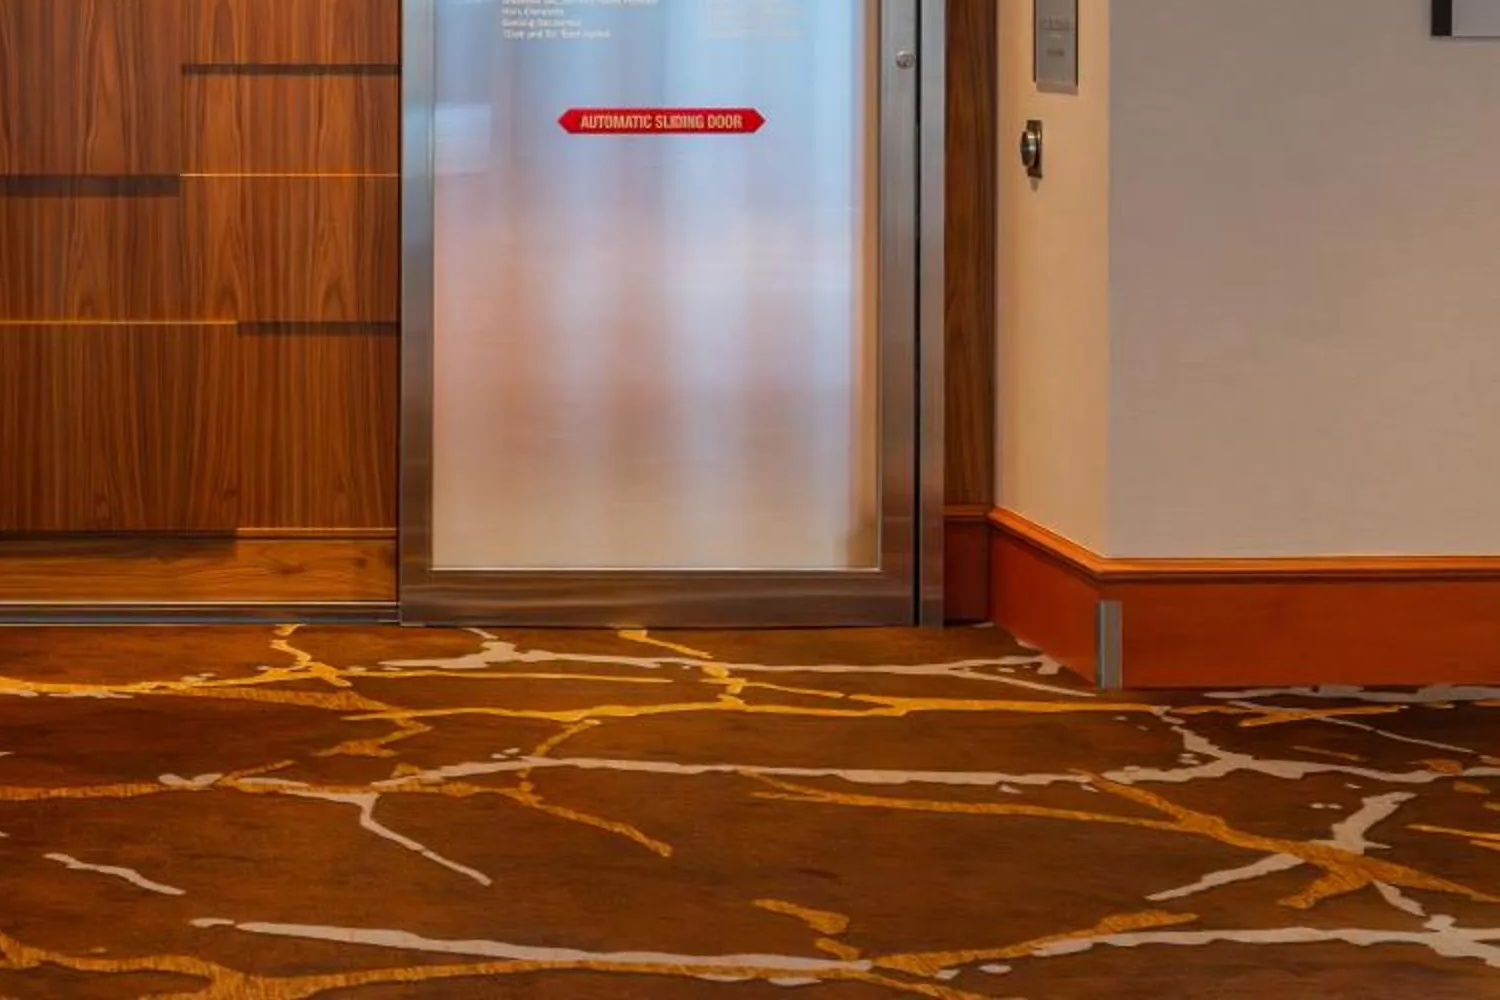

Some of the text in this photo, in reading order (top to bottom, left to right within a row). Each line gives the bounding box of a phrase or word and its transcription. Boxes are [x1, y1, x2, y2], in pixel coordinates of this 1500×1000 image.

[580, 115, 742, 129] AUTOMATIC SLIDING DOOR
